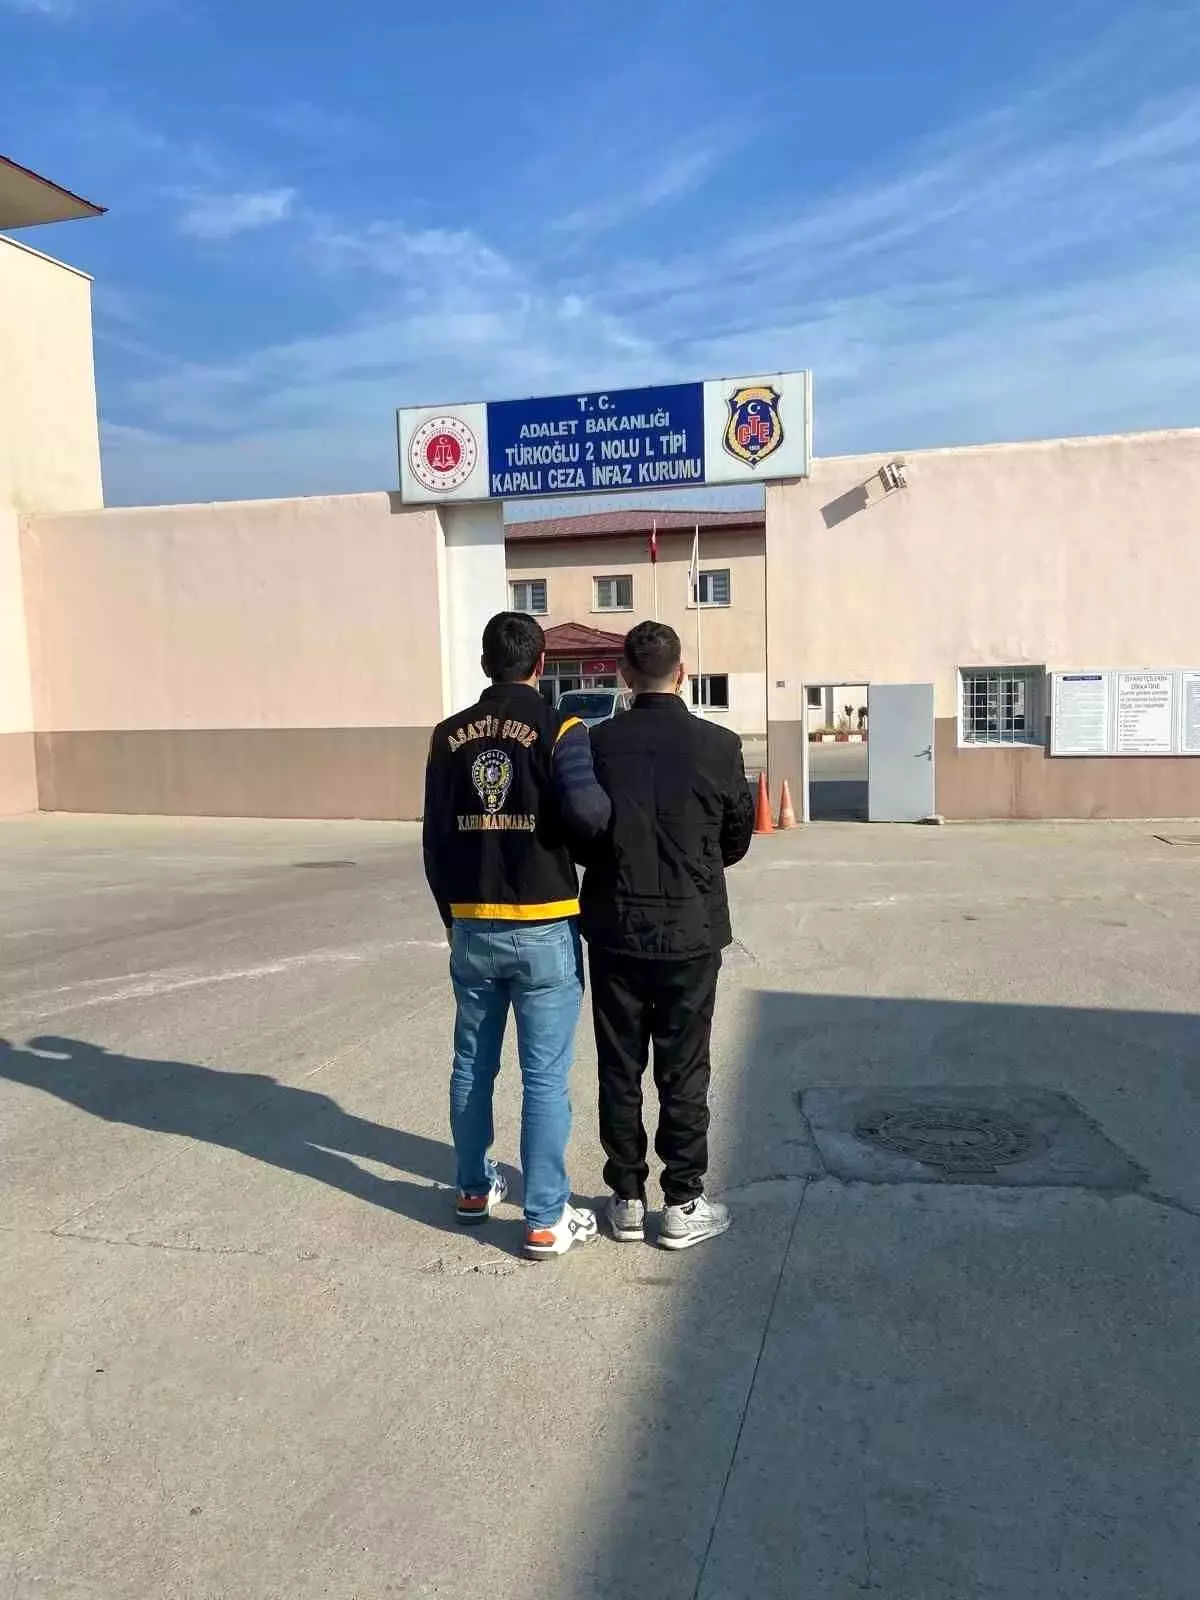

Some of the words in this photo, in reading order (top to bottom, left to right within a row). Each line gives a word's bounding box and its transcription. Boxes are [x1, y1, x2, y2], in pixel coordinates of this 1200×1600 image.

[577, 397, 594, 412] T.
[598, 395, 616, 410] C.
[520, 420, 579, 439] ADALET
[585, 407, 670, 433] BAKANLIĞI
[505, 440, 579, 467] TÜRKOĞLU
[585, 441, 594, 461] 2
[600, 438, 640, 460] NOLU
[645, 436, 655, 456] L
[659, 429, 686, 455] TİPİ
[492, 470, 542, 492] KAPALI
[548, 467, 585, 489] CEZA
[592, 462, 633, 486] İNFAZ
[639, 458, 701, 483] KURUMU
